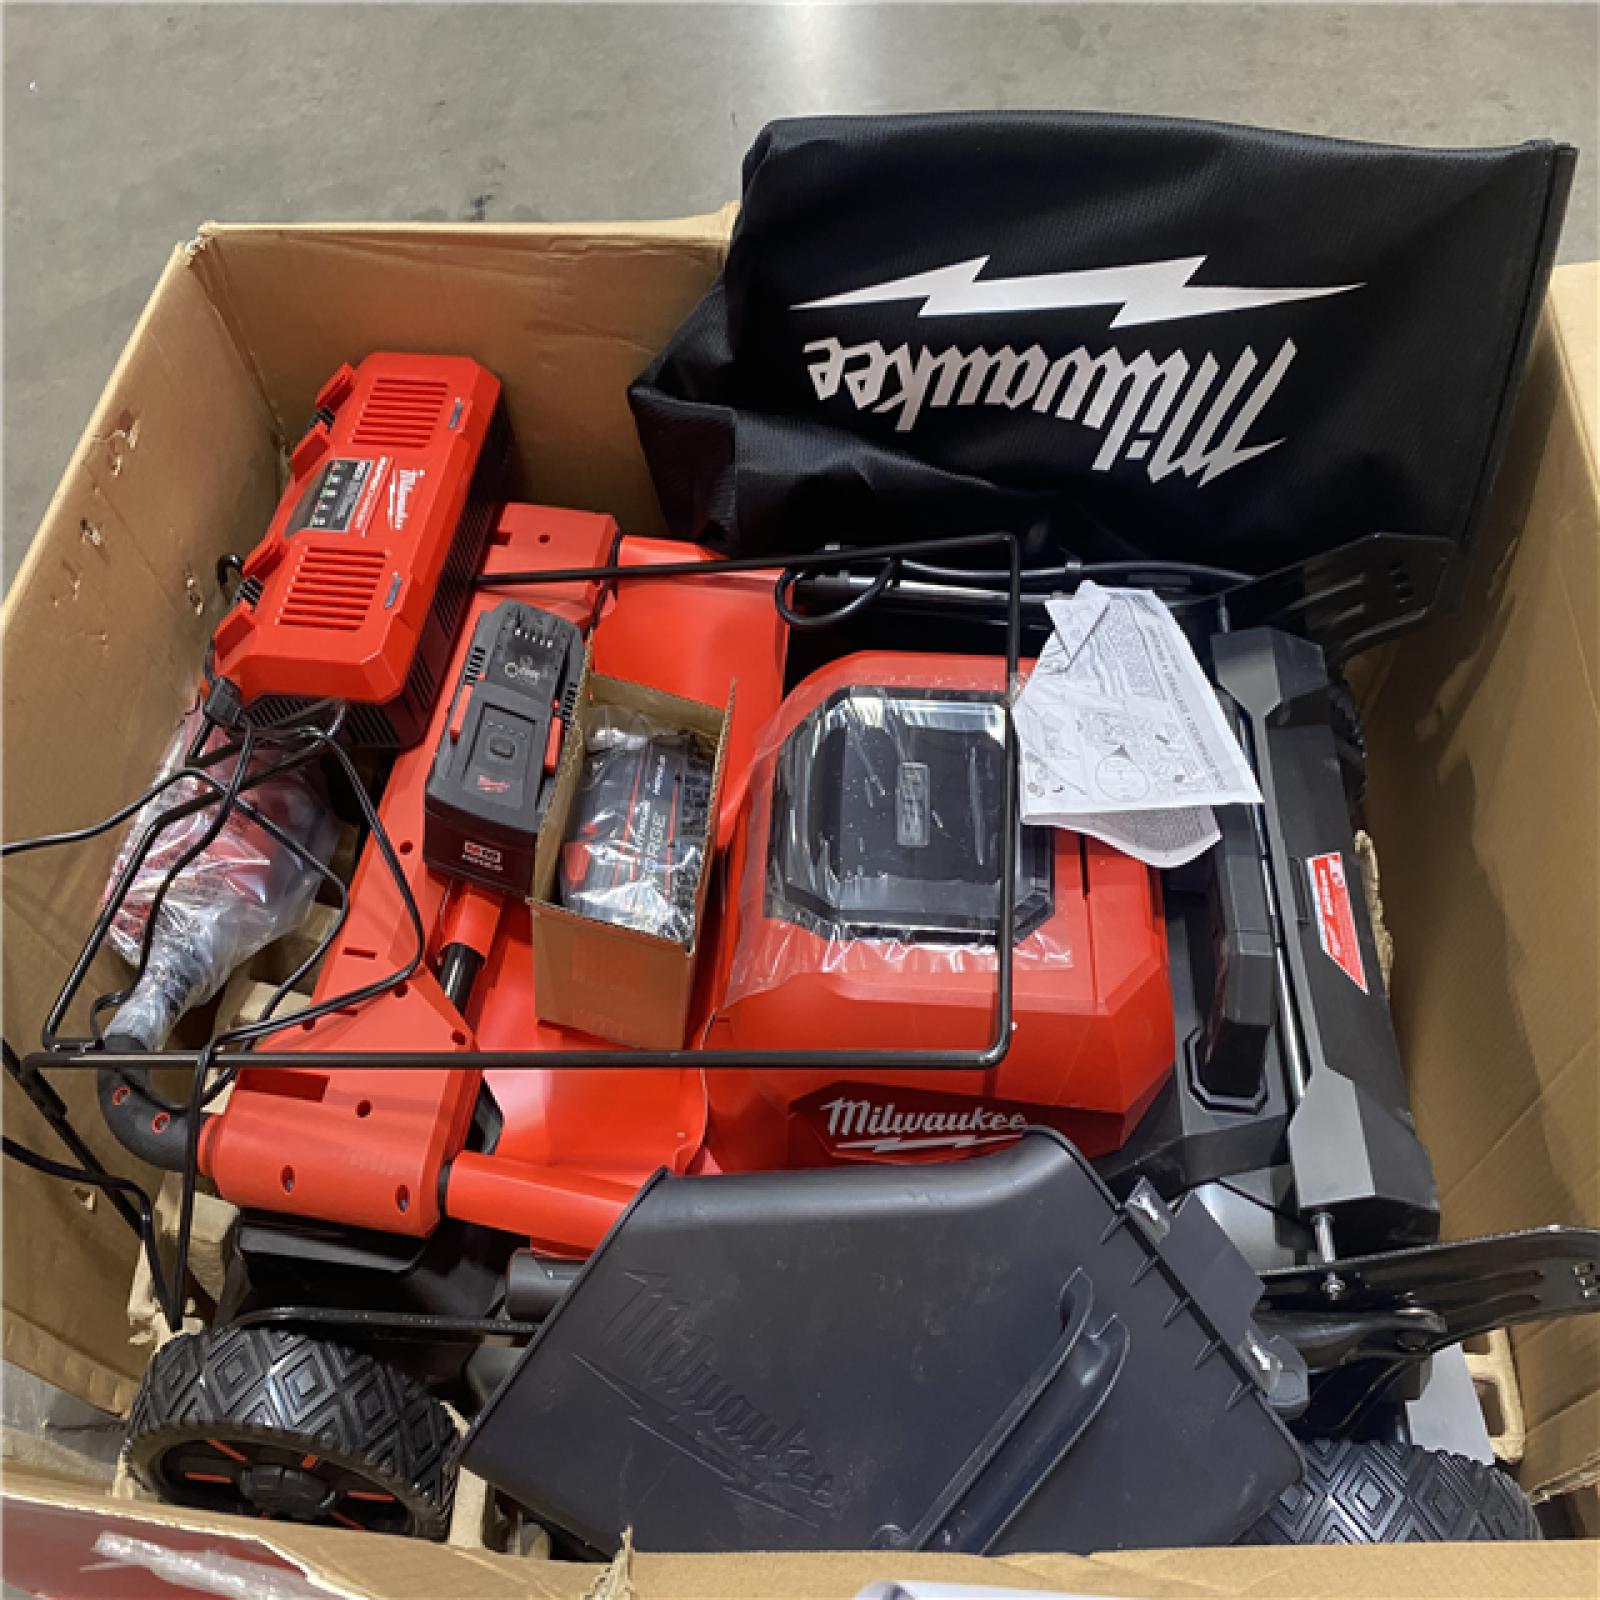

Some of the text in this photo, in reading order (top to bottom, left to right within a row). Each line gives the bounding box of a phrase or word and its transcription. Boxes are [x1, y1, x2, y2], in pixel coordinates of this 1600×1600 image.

[803, 336, 1297, 488] Milwaukee
[820, 1097, 1029, 1136] Milwaukee
[600, 1268, 834, 1510] Milwaukee
